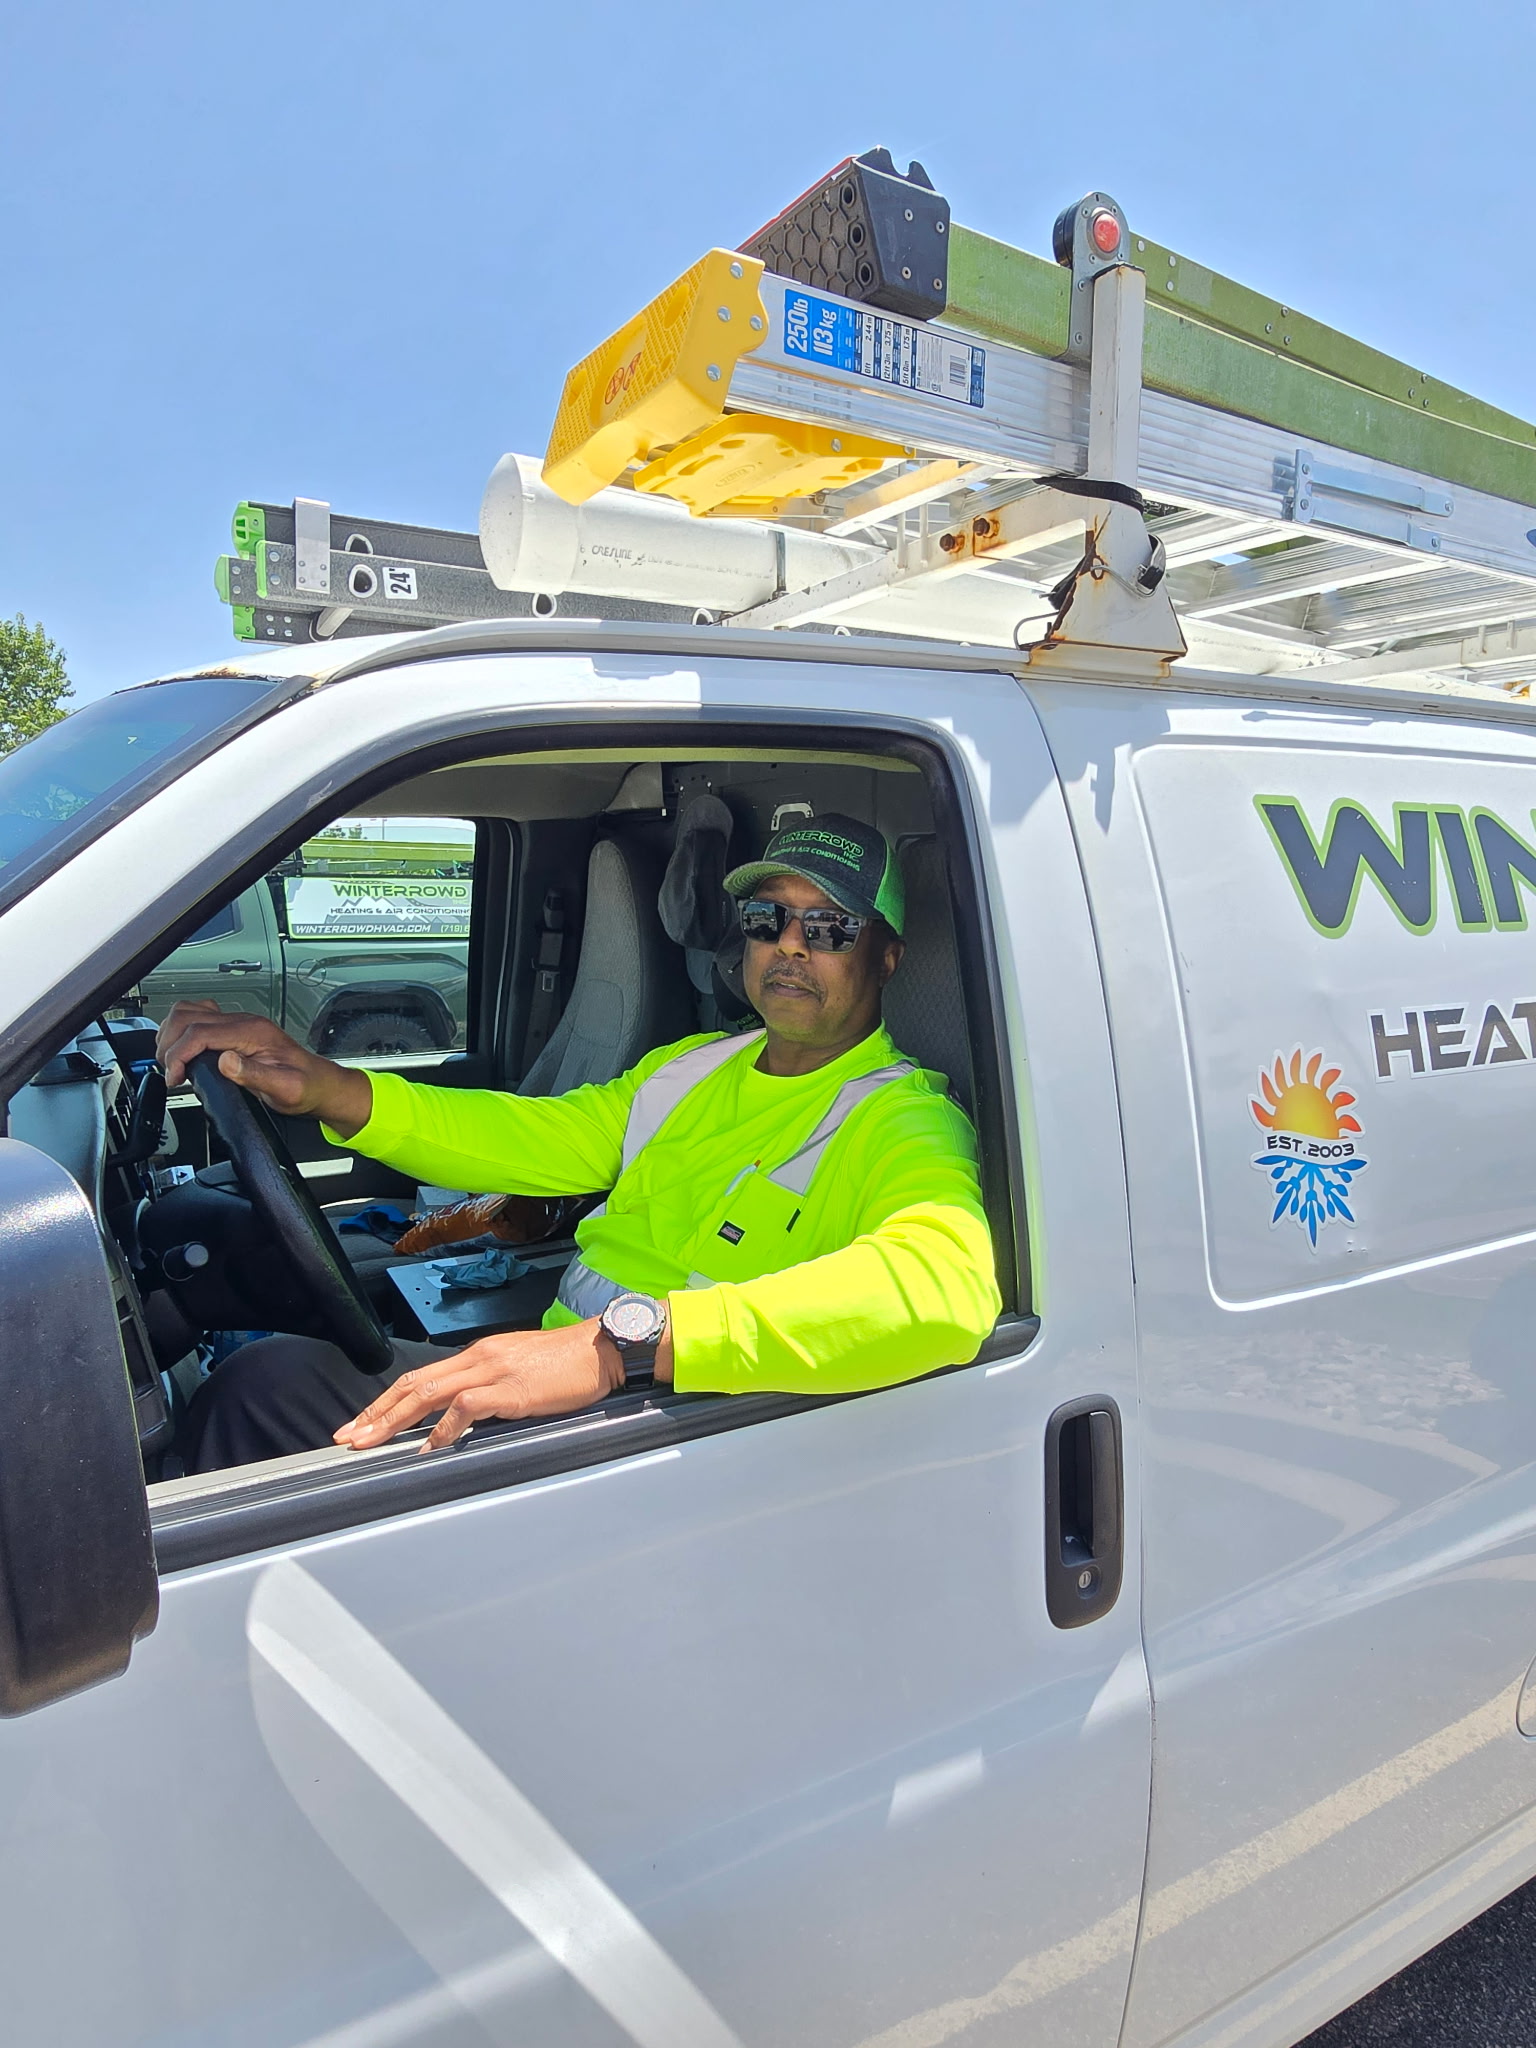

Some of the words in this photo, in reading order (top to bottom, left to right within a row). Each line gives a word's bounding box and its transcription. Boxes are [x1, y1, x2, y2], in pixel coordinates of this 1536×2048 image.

[786, 298, 809, 353] 250lb
[818, 307, 837, 329] kg
[812, 327, 834, 356] 113
[388, 567, 412, 595] 24'
[810, 848, 861, 872] CONDITIONING
[333, 884, 467, 897] WINTERROWD
[295, 924, 432, 934] WINTERROWDHVAC.COM
